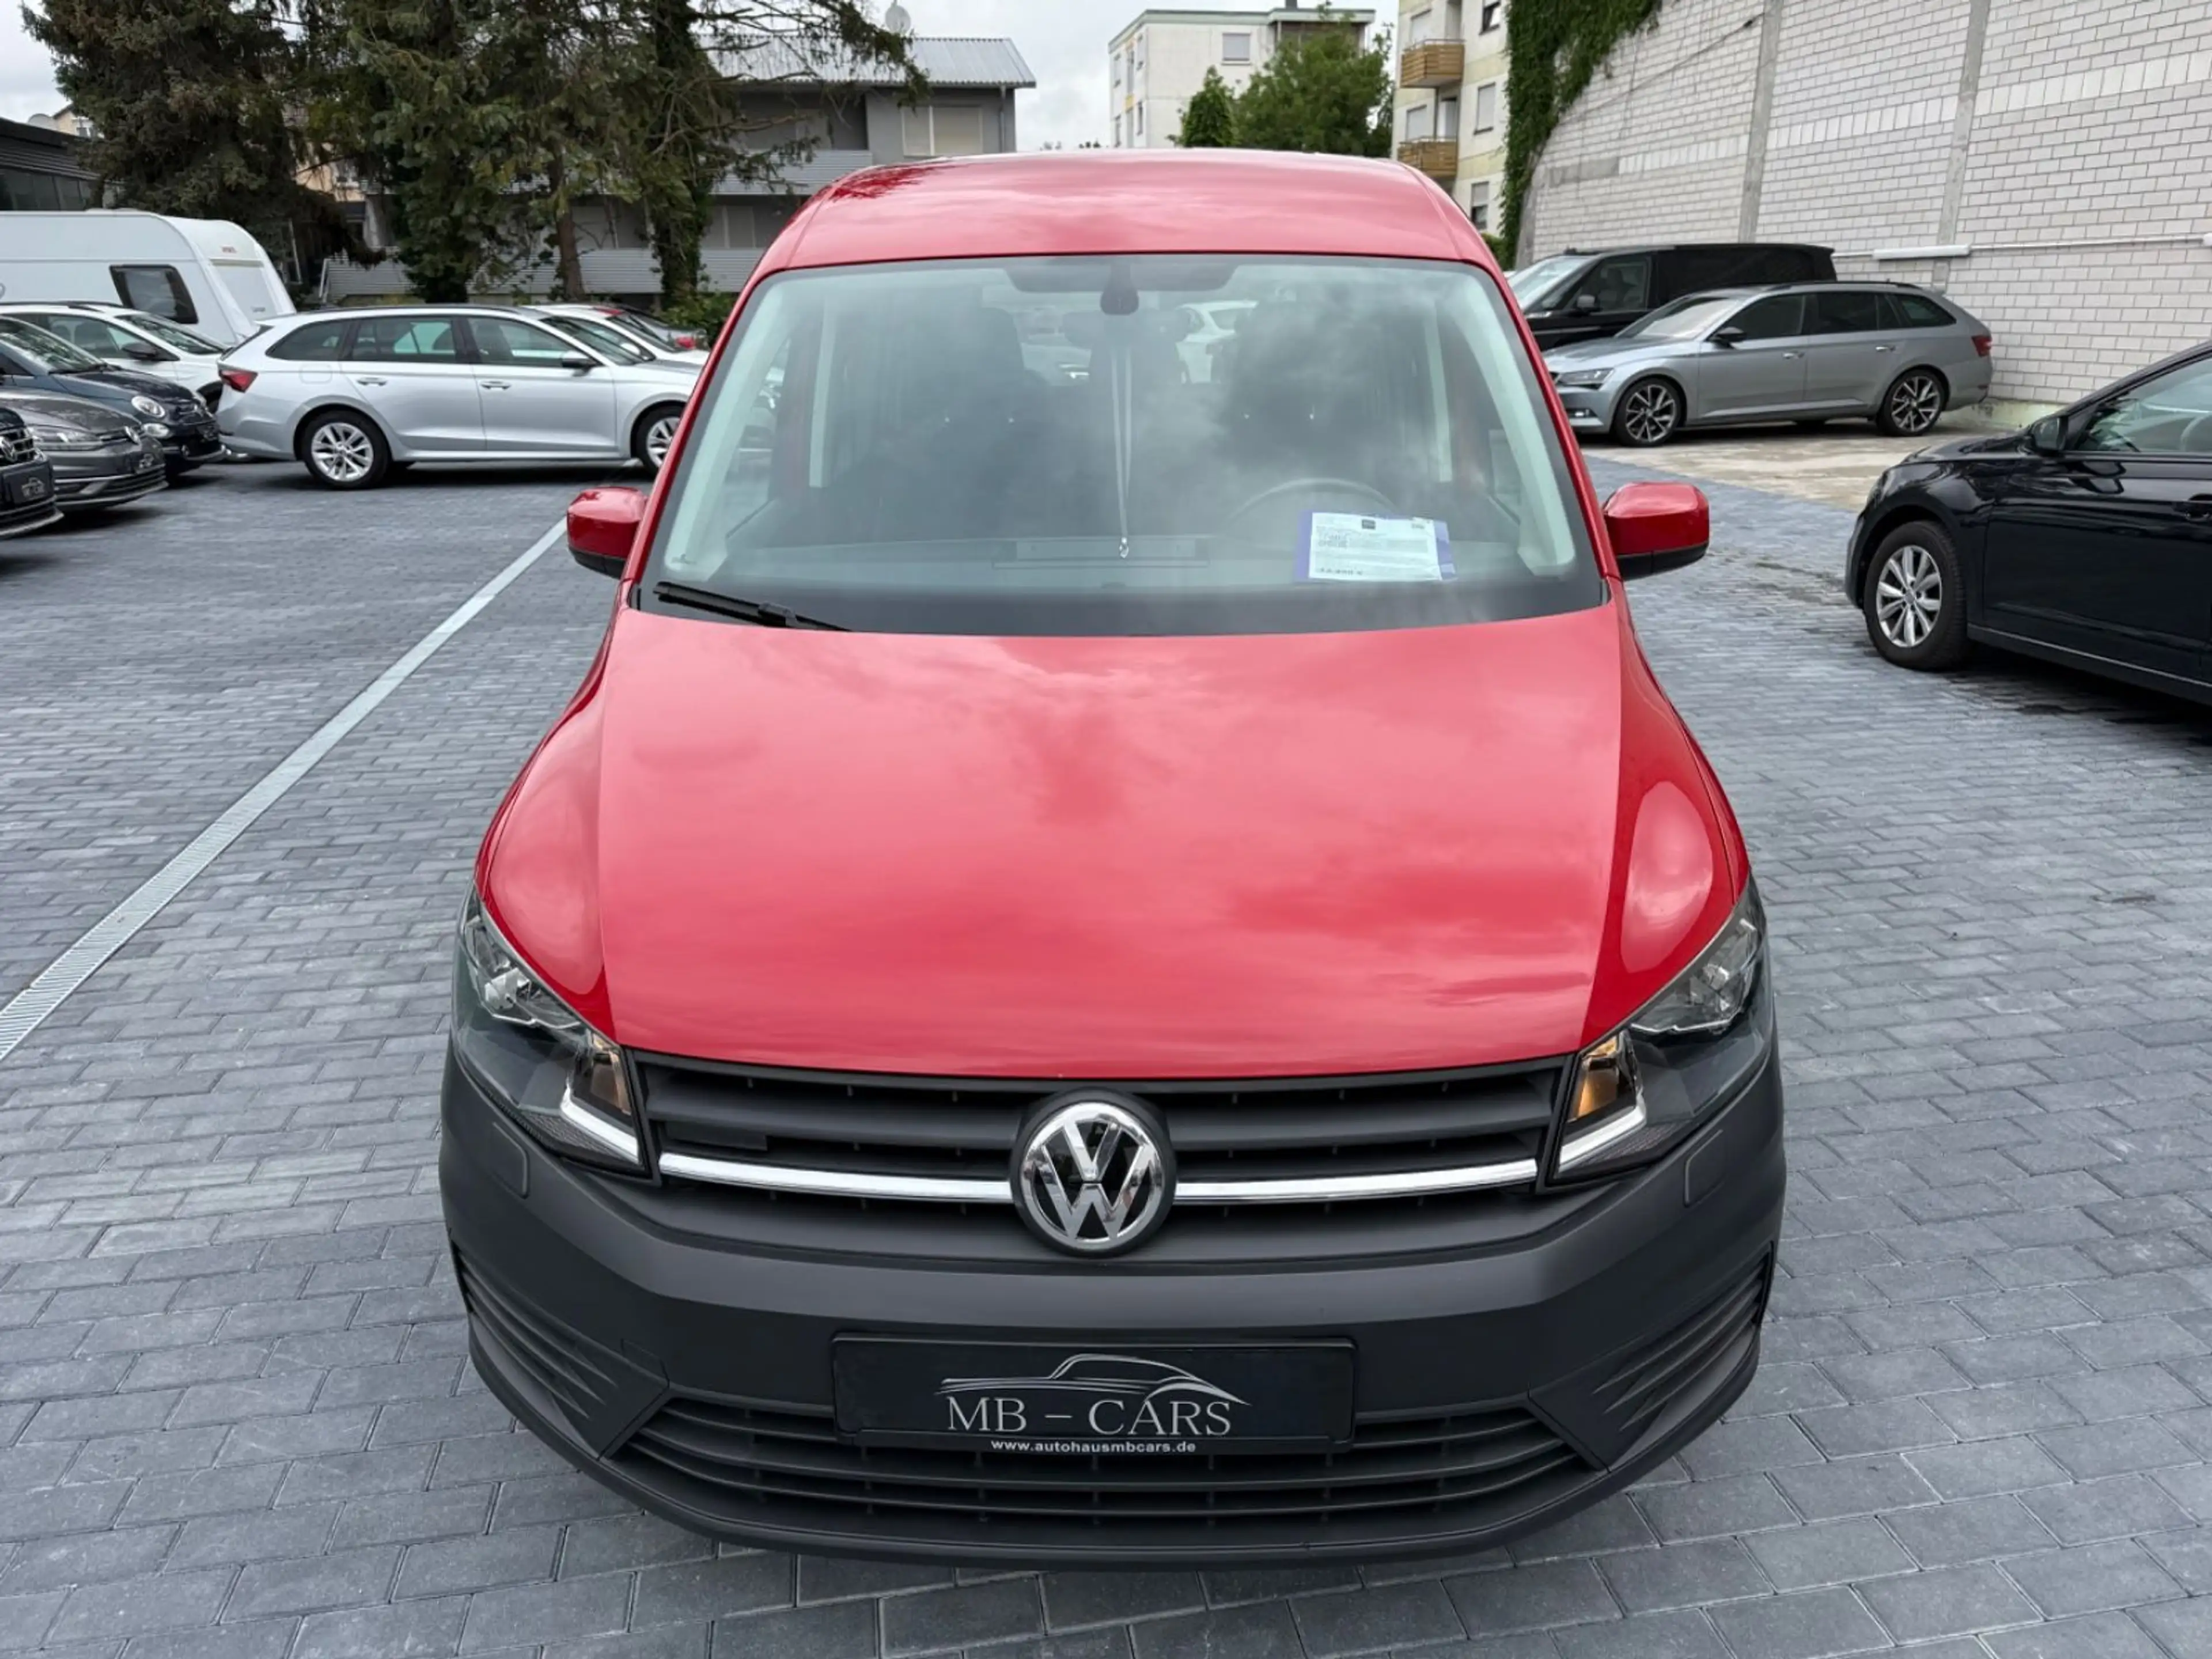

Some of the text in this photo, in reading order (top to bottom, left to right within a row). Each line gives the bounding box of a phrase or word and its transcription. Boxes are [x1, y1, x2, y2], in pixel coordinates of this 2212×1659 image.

[946, 1396, 1027, 1432] MB
[1088, 1399, 1231, 1435] CARS
[990, 1440, 1196, 1453] www.autohausmbcars.de
